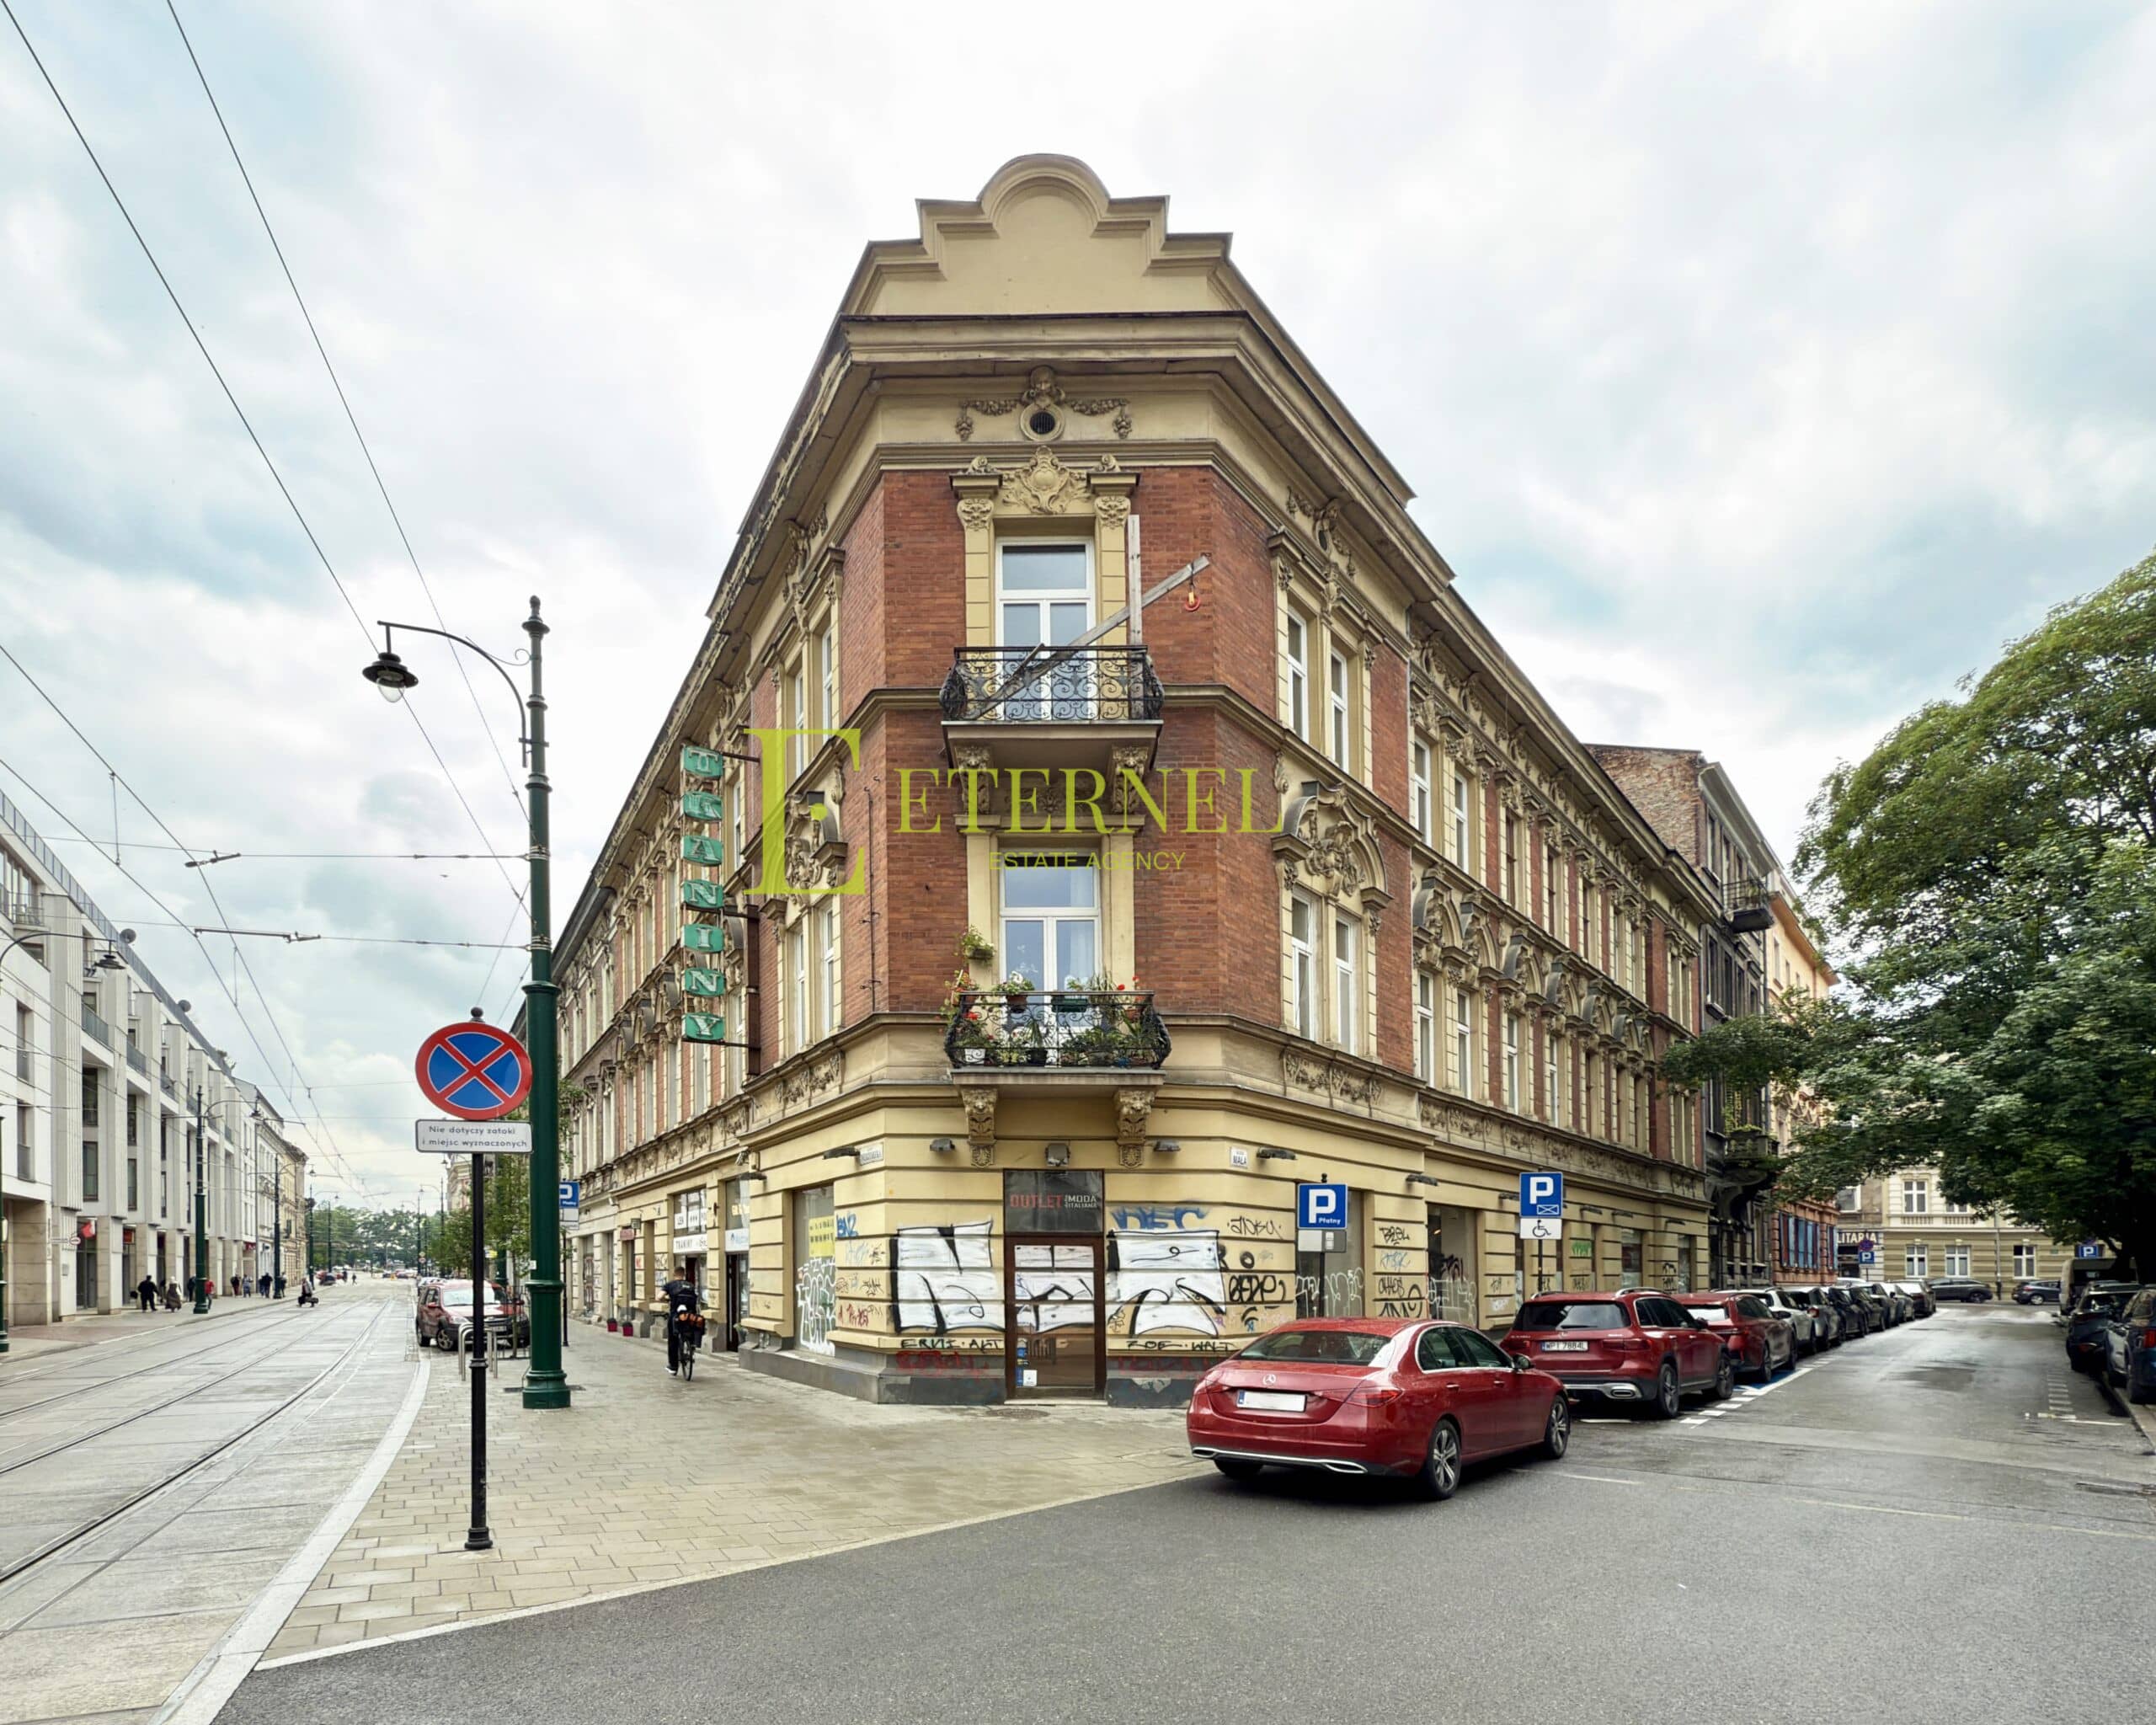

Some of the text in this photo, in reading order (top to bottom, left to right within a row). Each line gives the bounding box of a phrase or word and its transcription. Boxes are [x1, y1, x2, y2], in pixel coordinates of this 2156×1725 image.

[683, 748, 723, 1037] TKANINY
[449, 1126, 484, 1135] dotyczy
[429, 1138, 459, 1146] miejsc
[462, 1140, 527, 1148] wyznaczonych
[1529, 1177, 1553, 1204] P
[1010, 1194, 1063, 1209] OUTLET
[1309, 1188, 1337, 1224] P
[1319, 1217, 1341, 1226] Płatny
